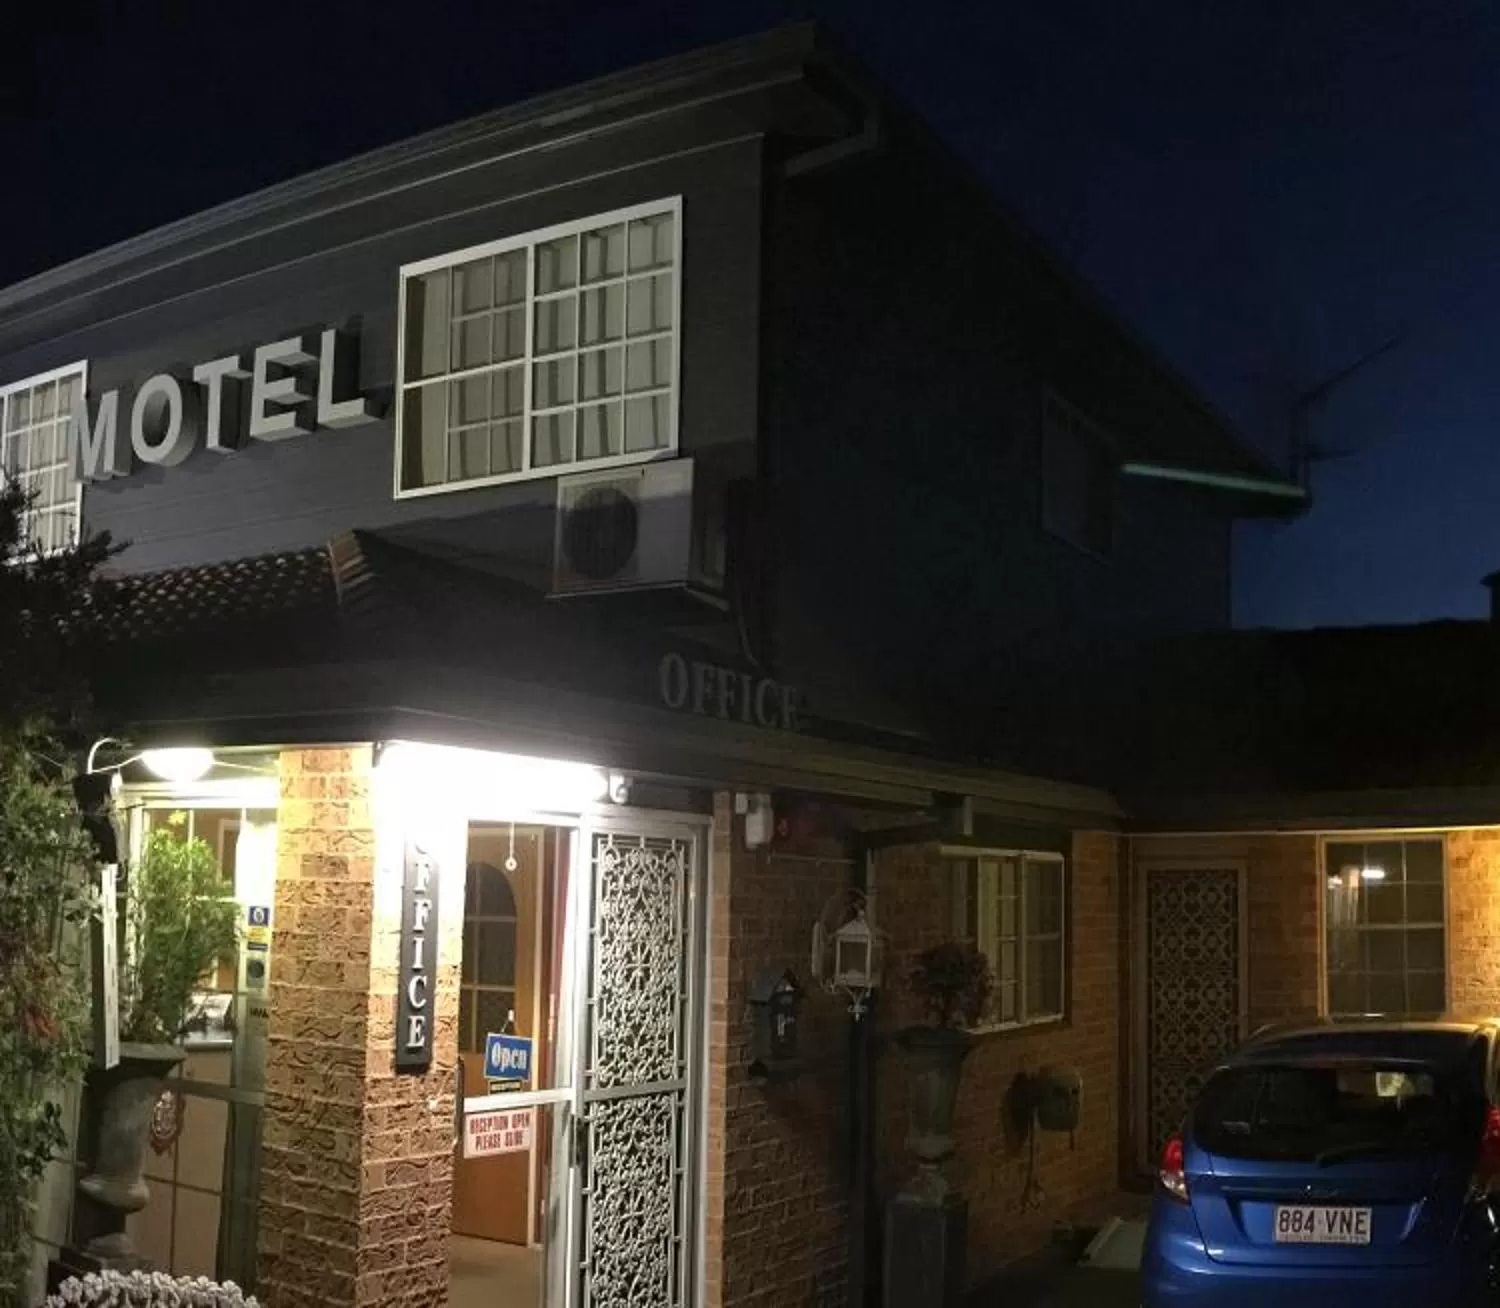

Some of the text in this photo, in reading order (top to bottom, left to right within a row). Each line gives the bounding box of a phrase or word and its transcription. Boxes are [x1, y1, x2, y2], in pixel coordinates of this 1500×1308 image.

[68, 328, 366, 484] MOTEL
[407, 838, 433, 1048] FFICE
[491, 1042, 527, 1072] Open
[475, 1133, 501, 1152] PLEASE
[1279, 1208, 1369, 1235] 884 VNE
